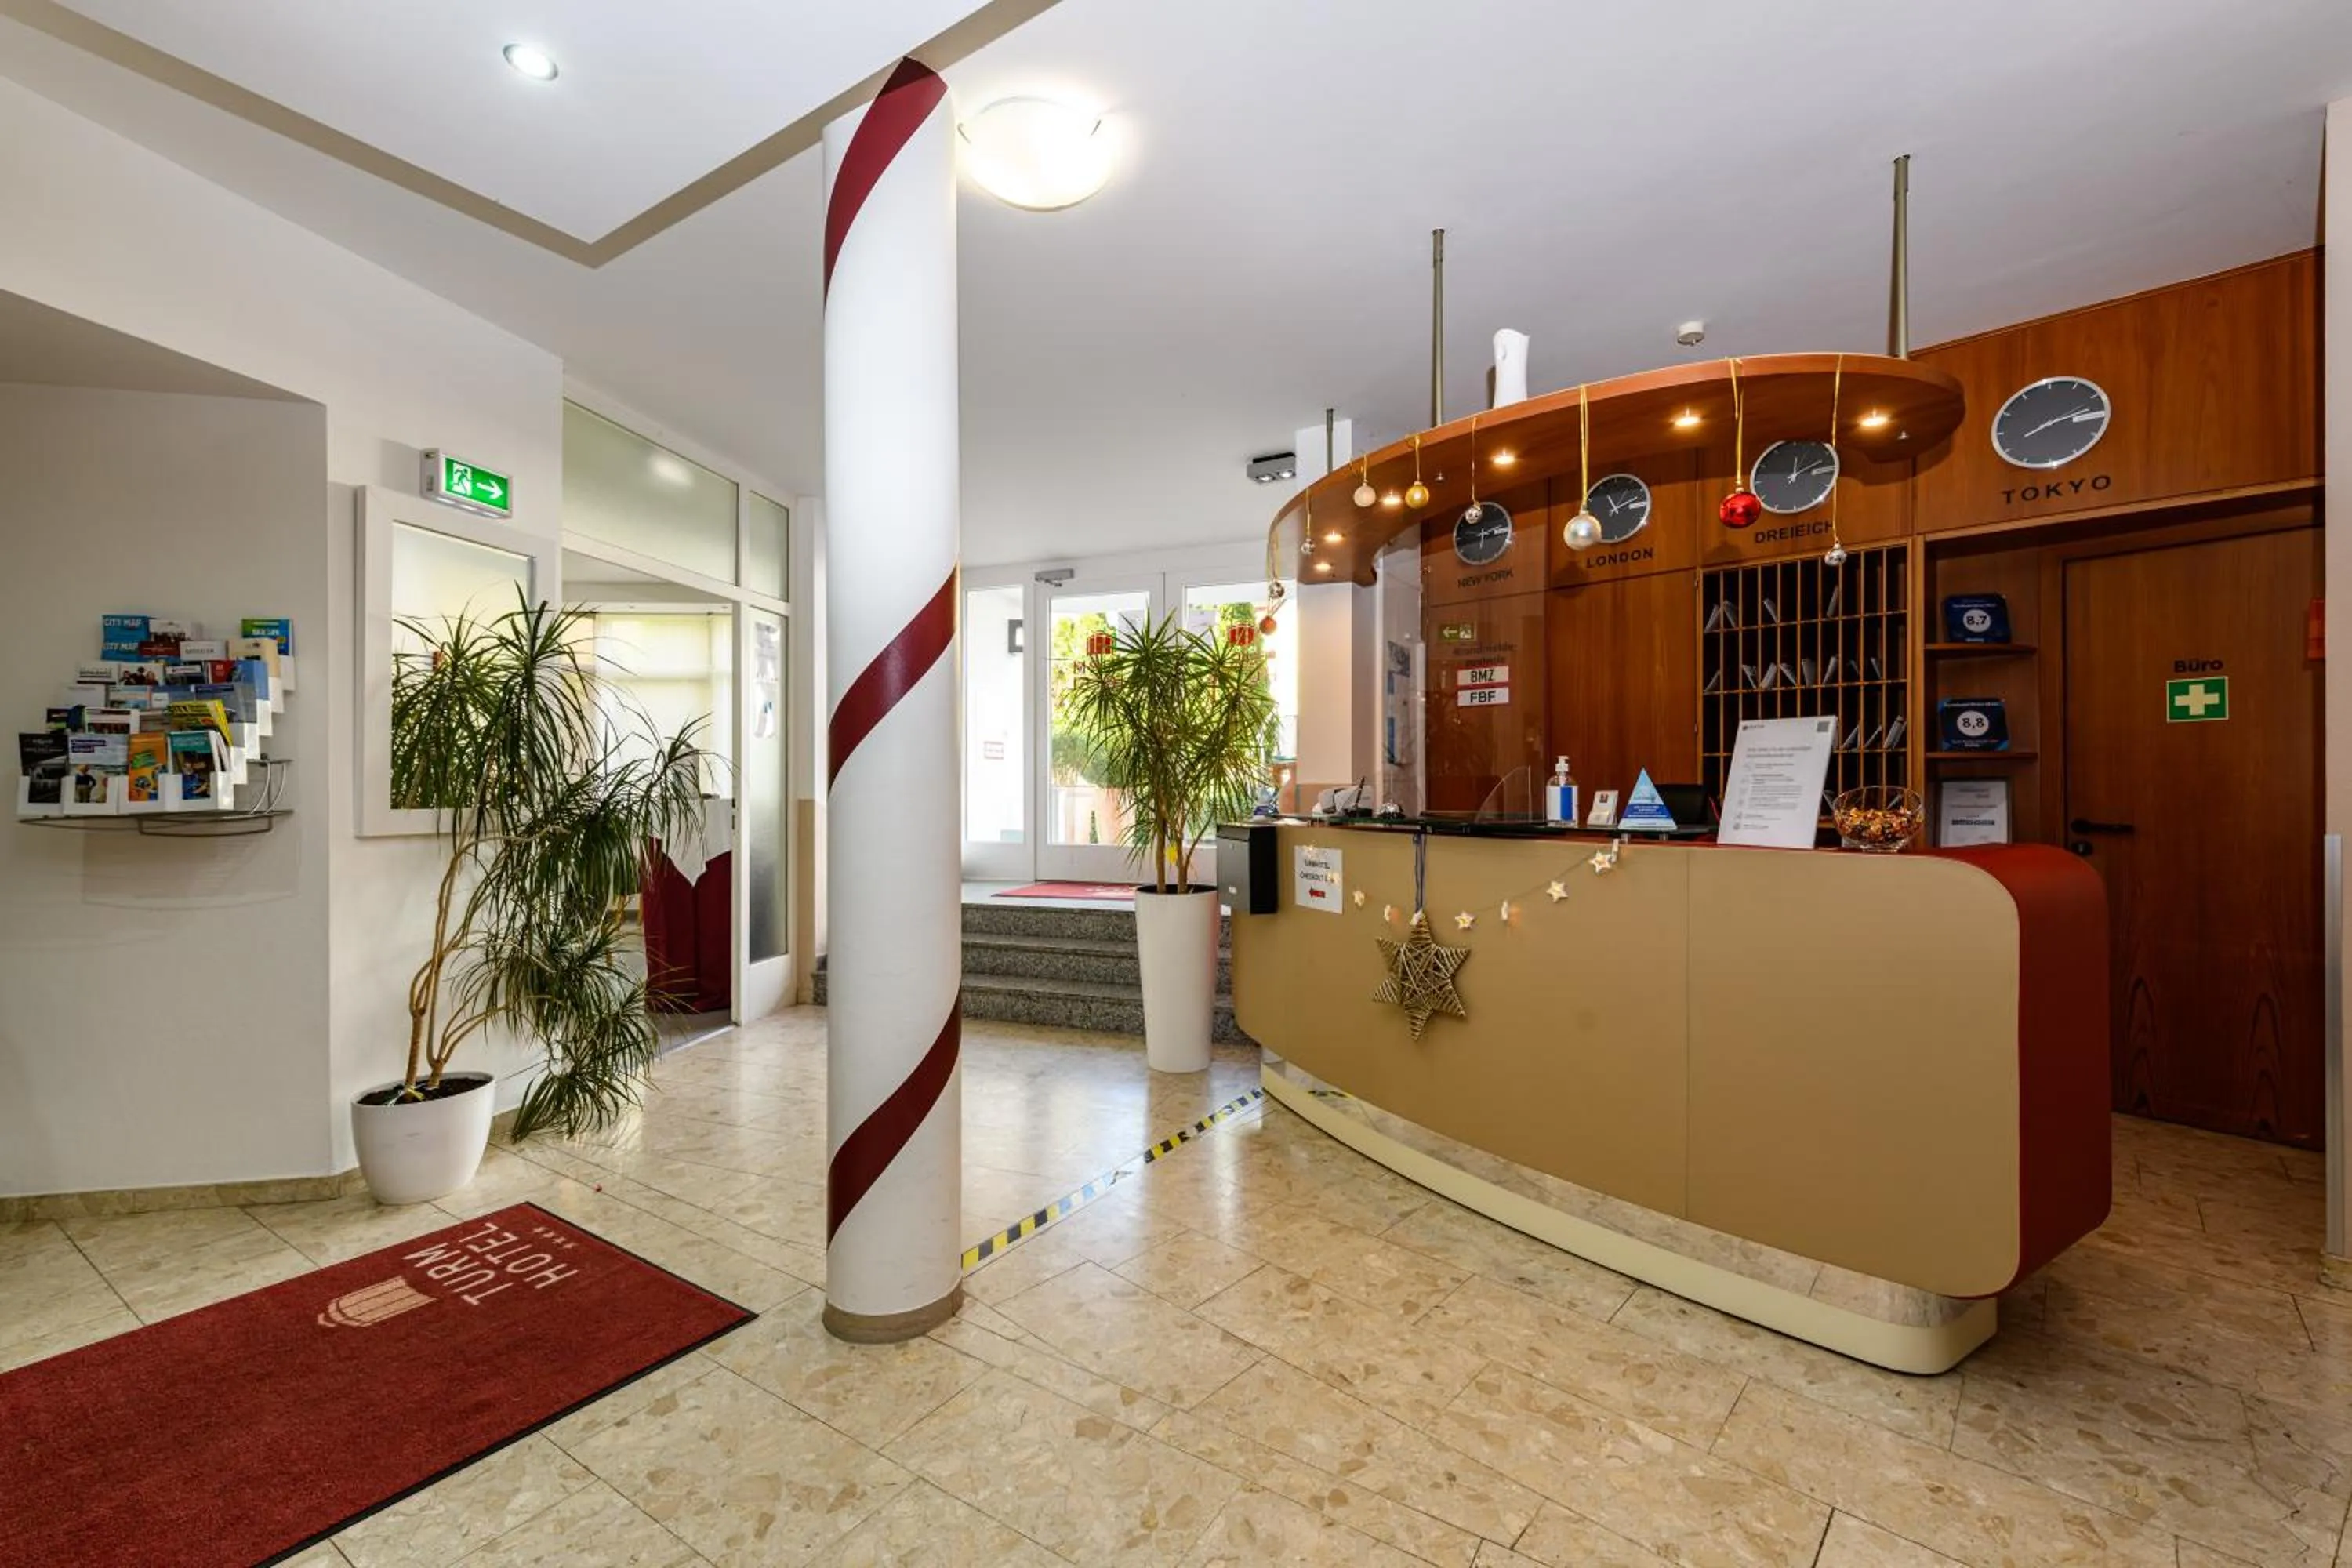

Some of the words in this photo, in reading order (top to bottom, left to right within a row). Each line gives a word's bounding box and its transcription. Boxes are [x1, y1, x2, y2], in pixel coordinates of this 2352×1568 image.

[2000, 475, 2111, 505] TOKYO
[1586, 546, 1653, 568] LONDON
[1457, 576, 1481, 588] NEW
[1483, 568, 1514, 583] YORK
[104, 618, 122, 627] CITY
[123, 618, 142, 628] MAP
[1470, 669, 1494, 683] BMZ
[2174, 659, 2224, 673] Büro
[1470, 691, 1497, 704] FBF
[459, 1221, 579, 1290] HOTEL
[401, 1242, 515, 1306] TURM
